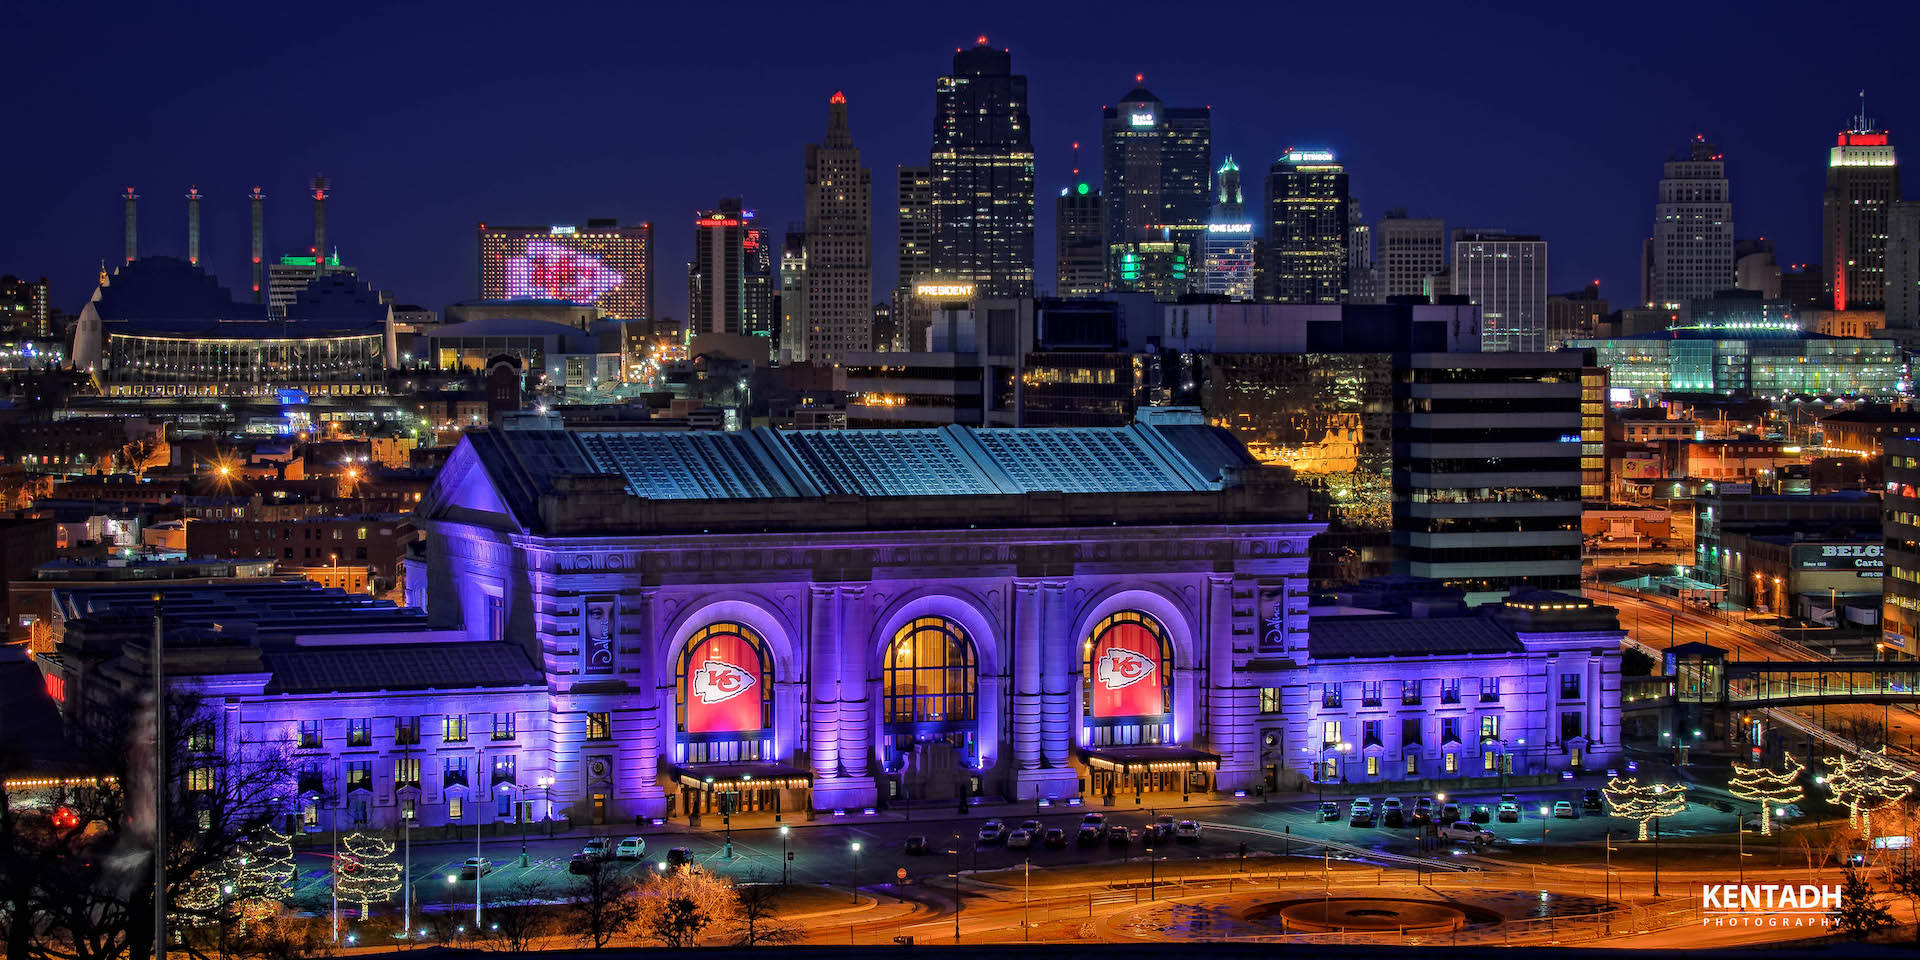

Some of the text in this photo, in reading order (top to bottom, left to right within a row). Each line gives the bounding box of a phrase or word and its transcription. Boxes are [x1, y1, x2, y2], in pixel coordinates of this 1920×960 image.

[1209, 224, 1252, 232] ONE LIGHT
[918, 285, 973, 295] PRESIDENT
[1112, 656, 1142, 678] KC
[708, 670, 741, 693] KC
